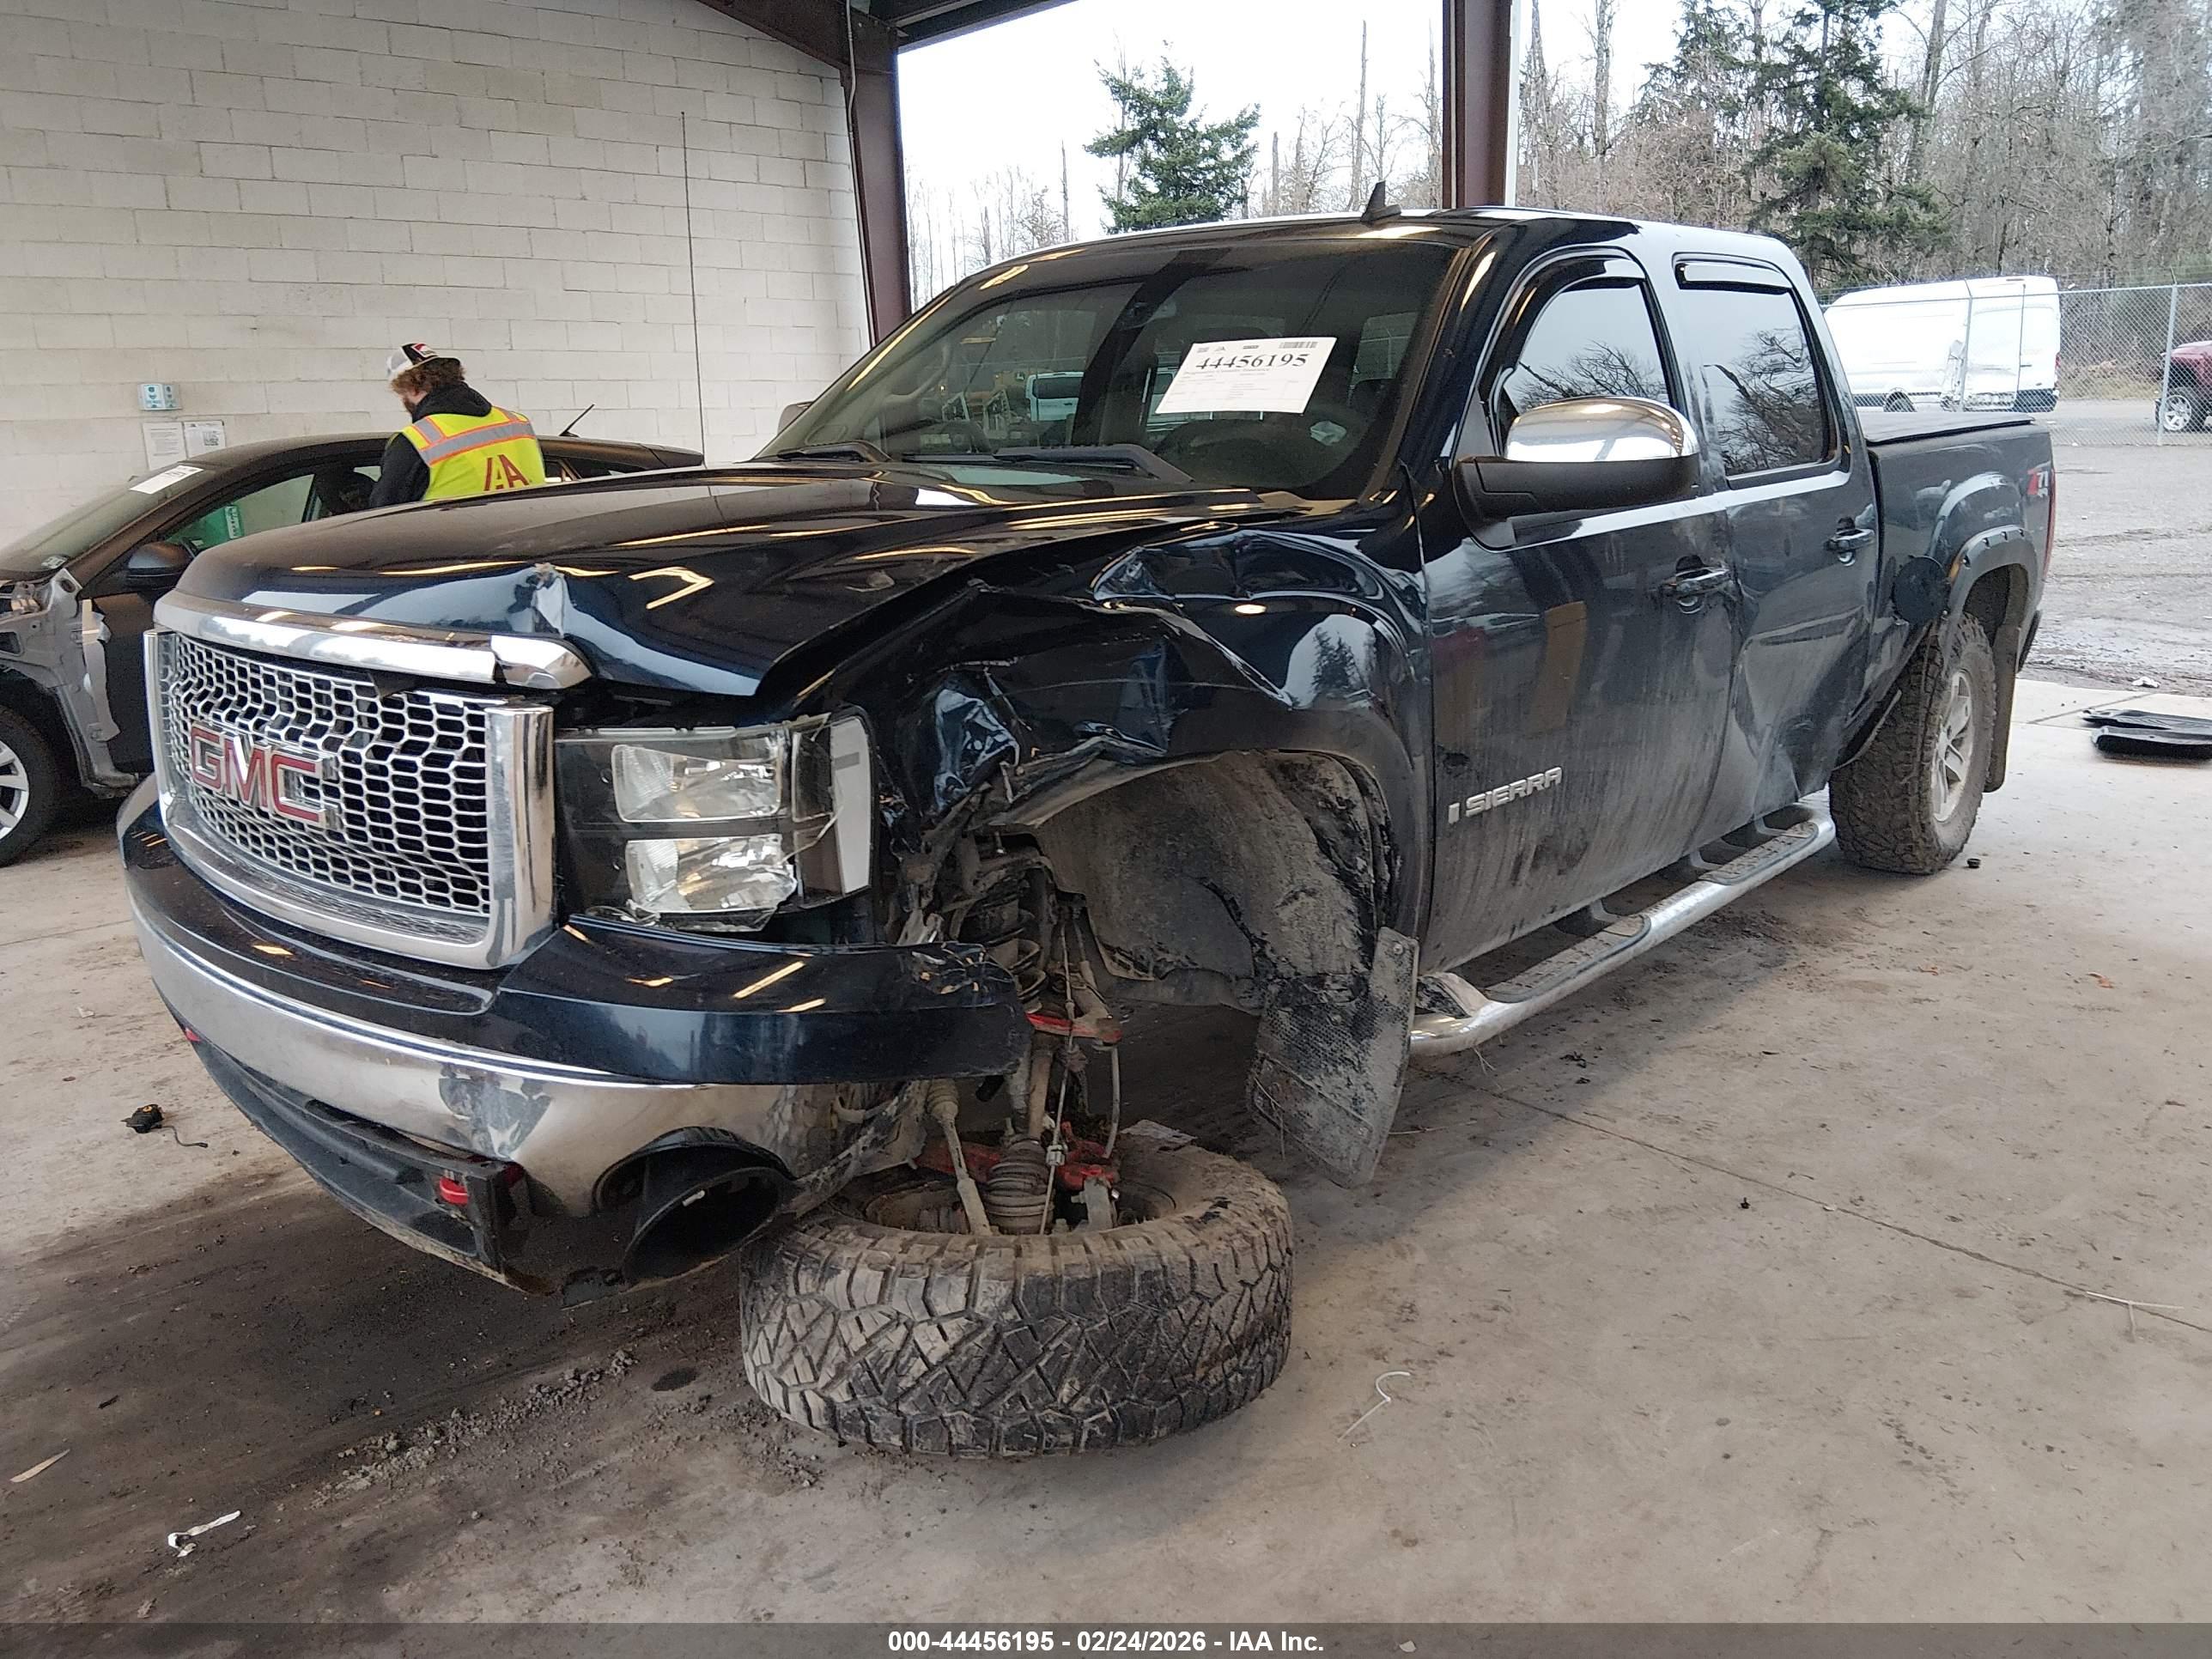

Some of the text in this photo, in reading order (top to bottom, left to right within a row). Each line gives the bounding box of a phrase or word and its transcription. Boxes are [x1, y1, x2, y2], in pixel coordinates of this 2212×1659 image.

[1194, 353, 1311, 370] 44456195
[190, 720, 331, 830] GMC
[1466, 766, 1563, 818] SIERRA
